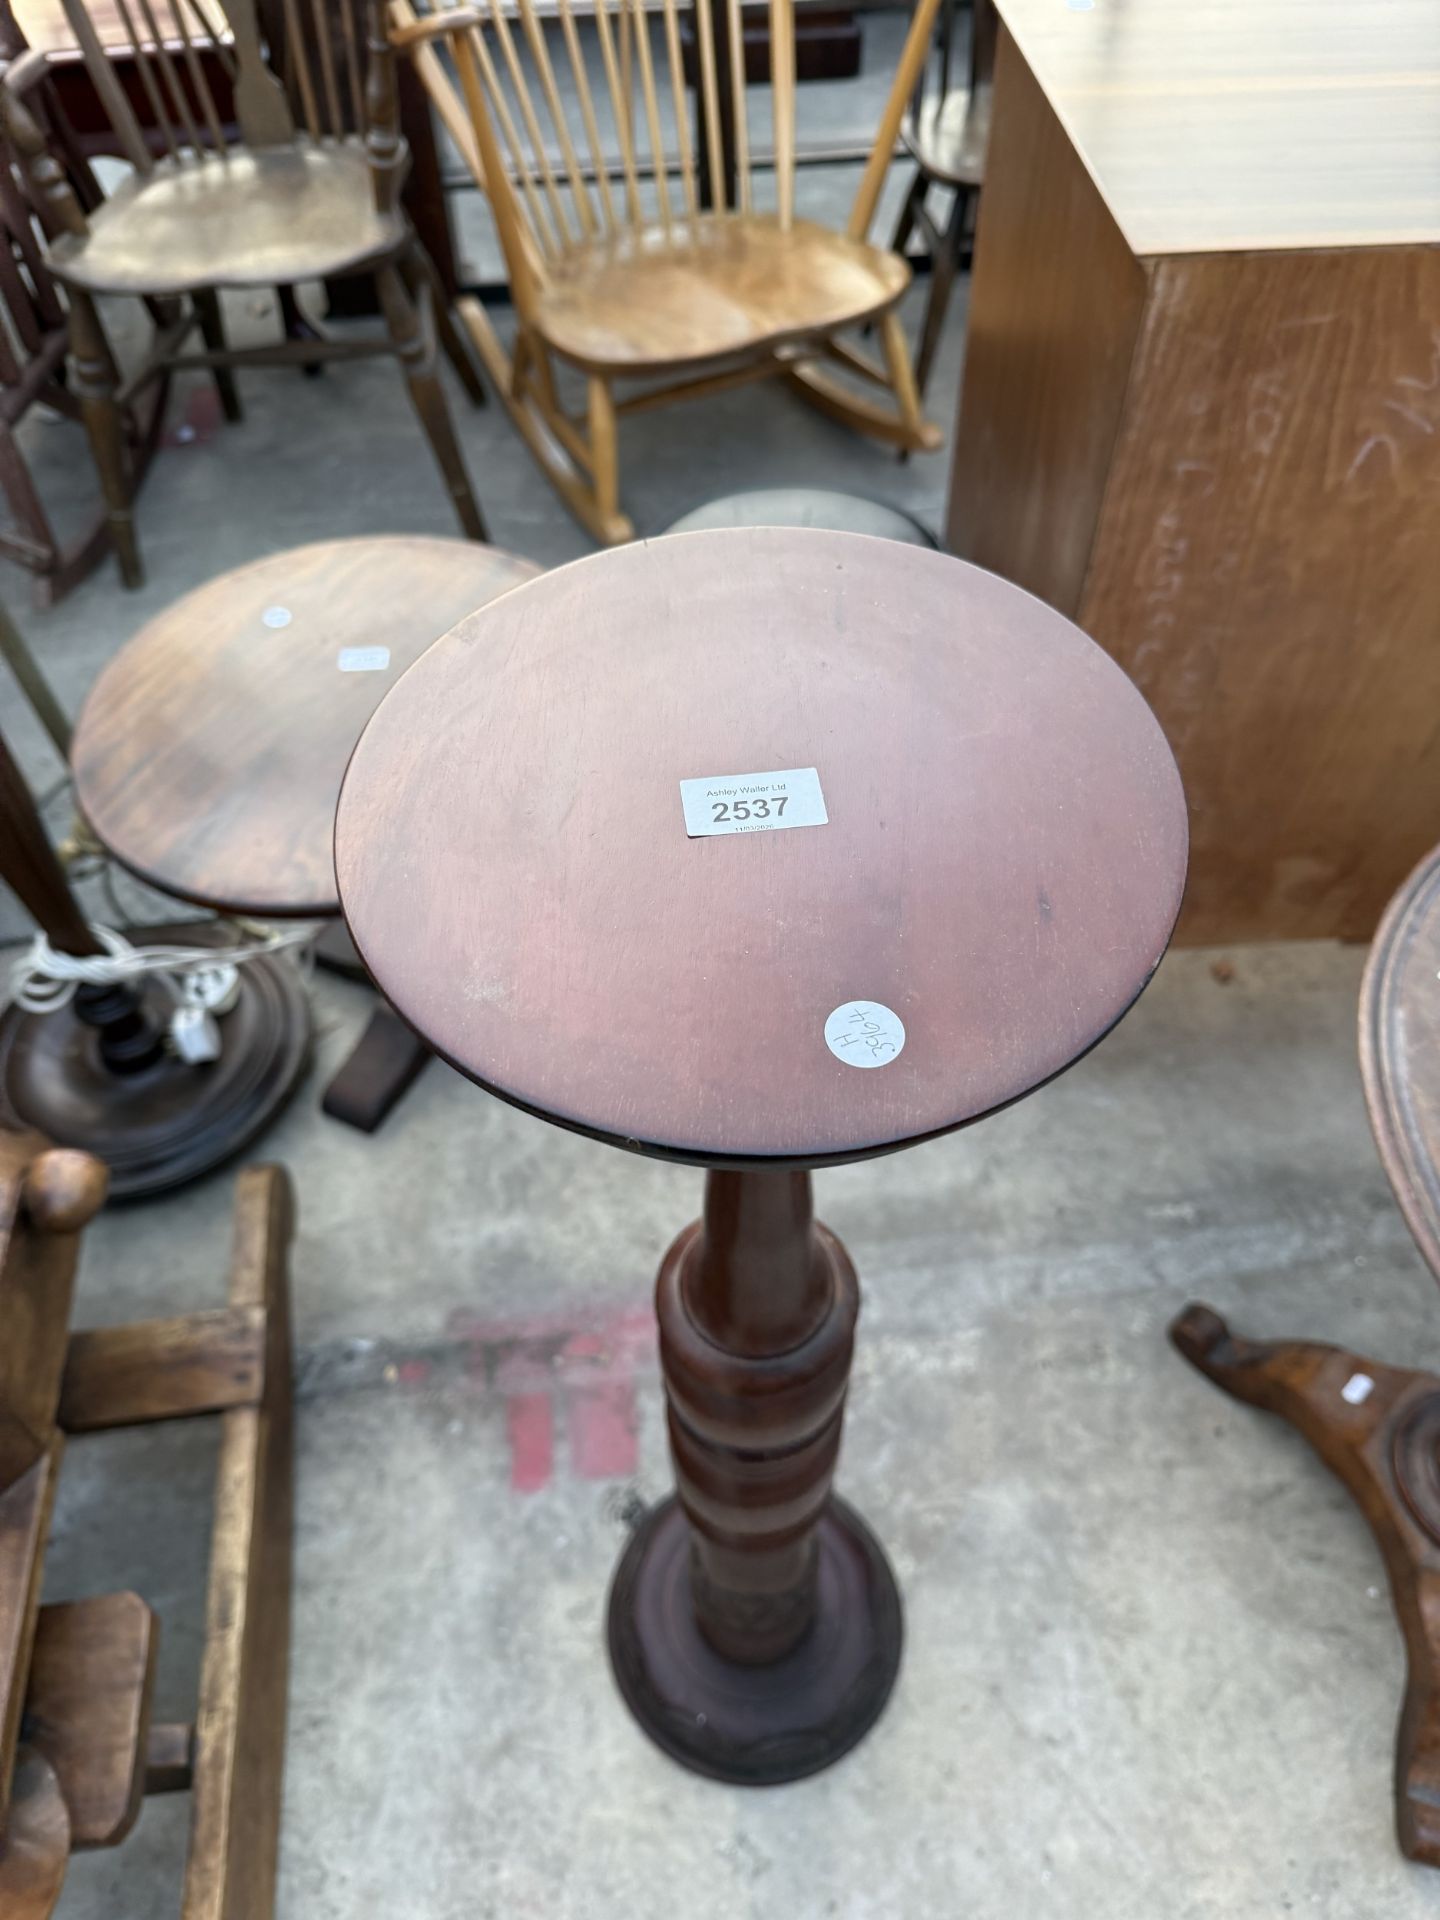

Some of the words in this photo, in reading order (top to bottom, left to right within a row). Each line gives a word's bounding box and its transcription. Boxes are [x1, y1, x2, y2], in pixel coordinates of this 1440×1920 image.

[707, 788, 737, 797] Ashley
[740, 785, 769, 794] Waller
[771, 783, 786, 791] Ltd
[712, 797, 788, 822] 2537
